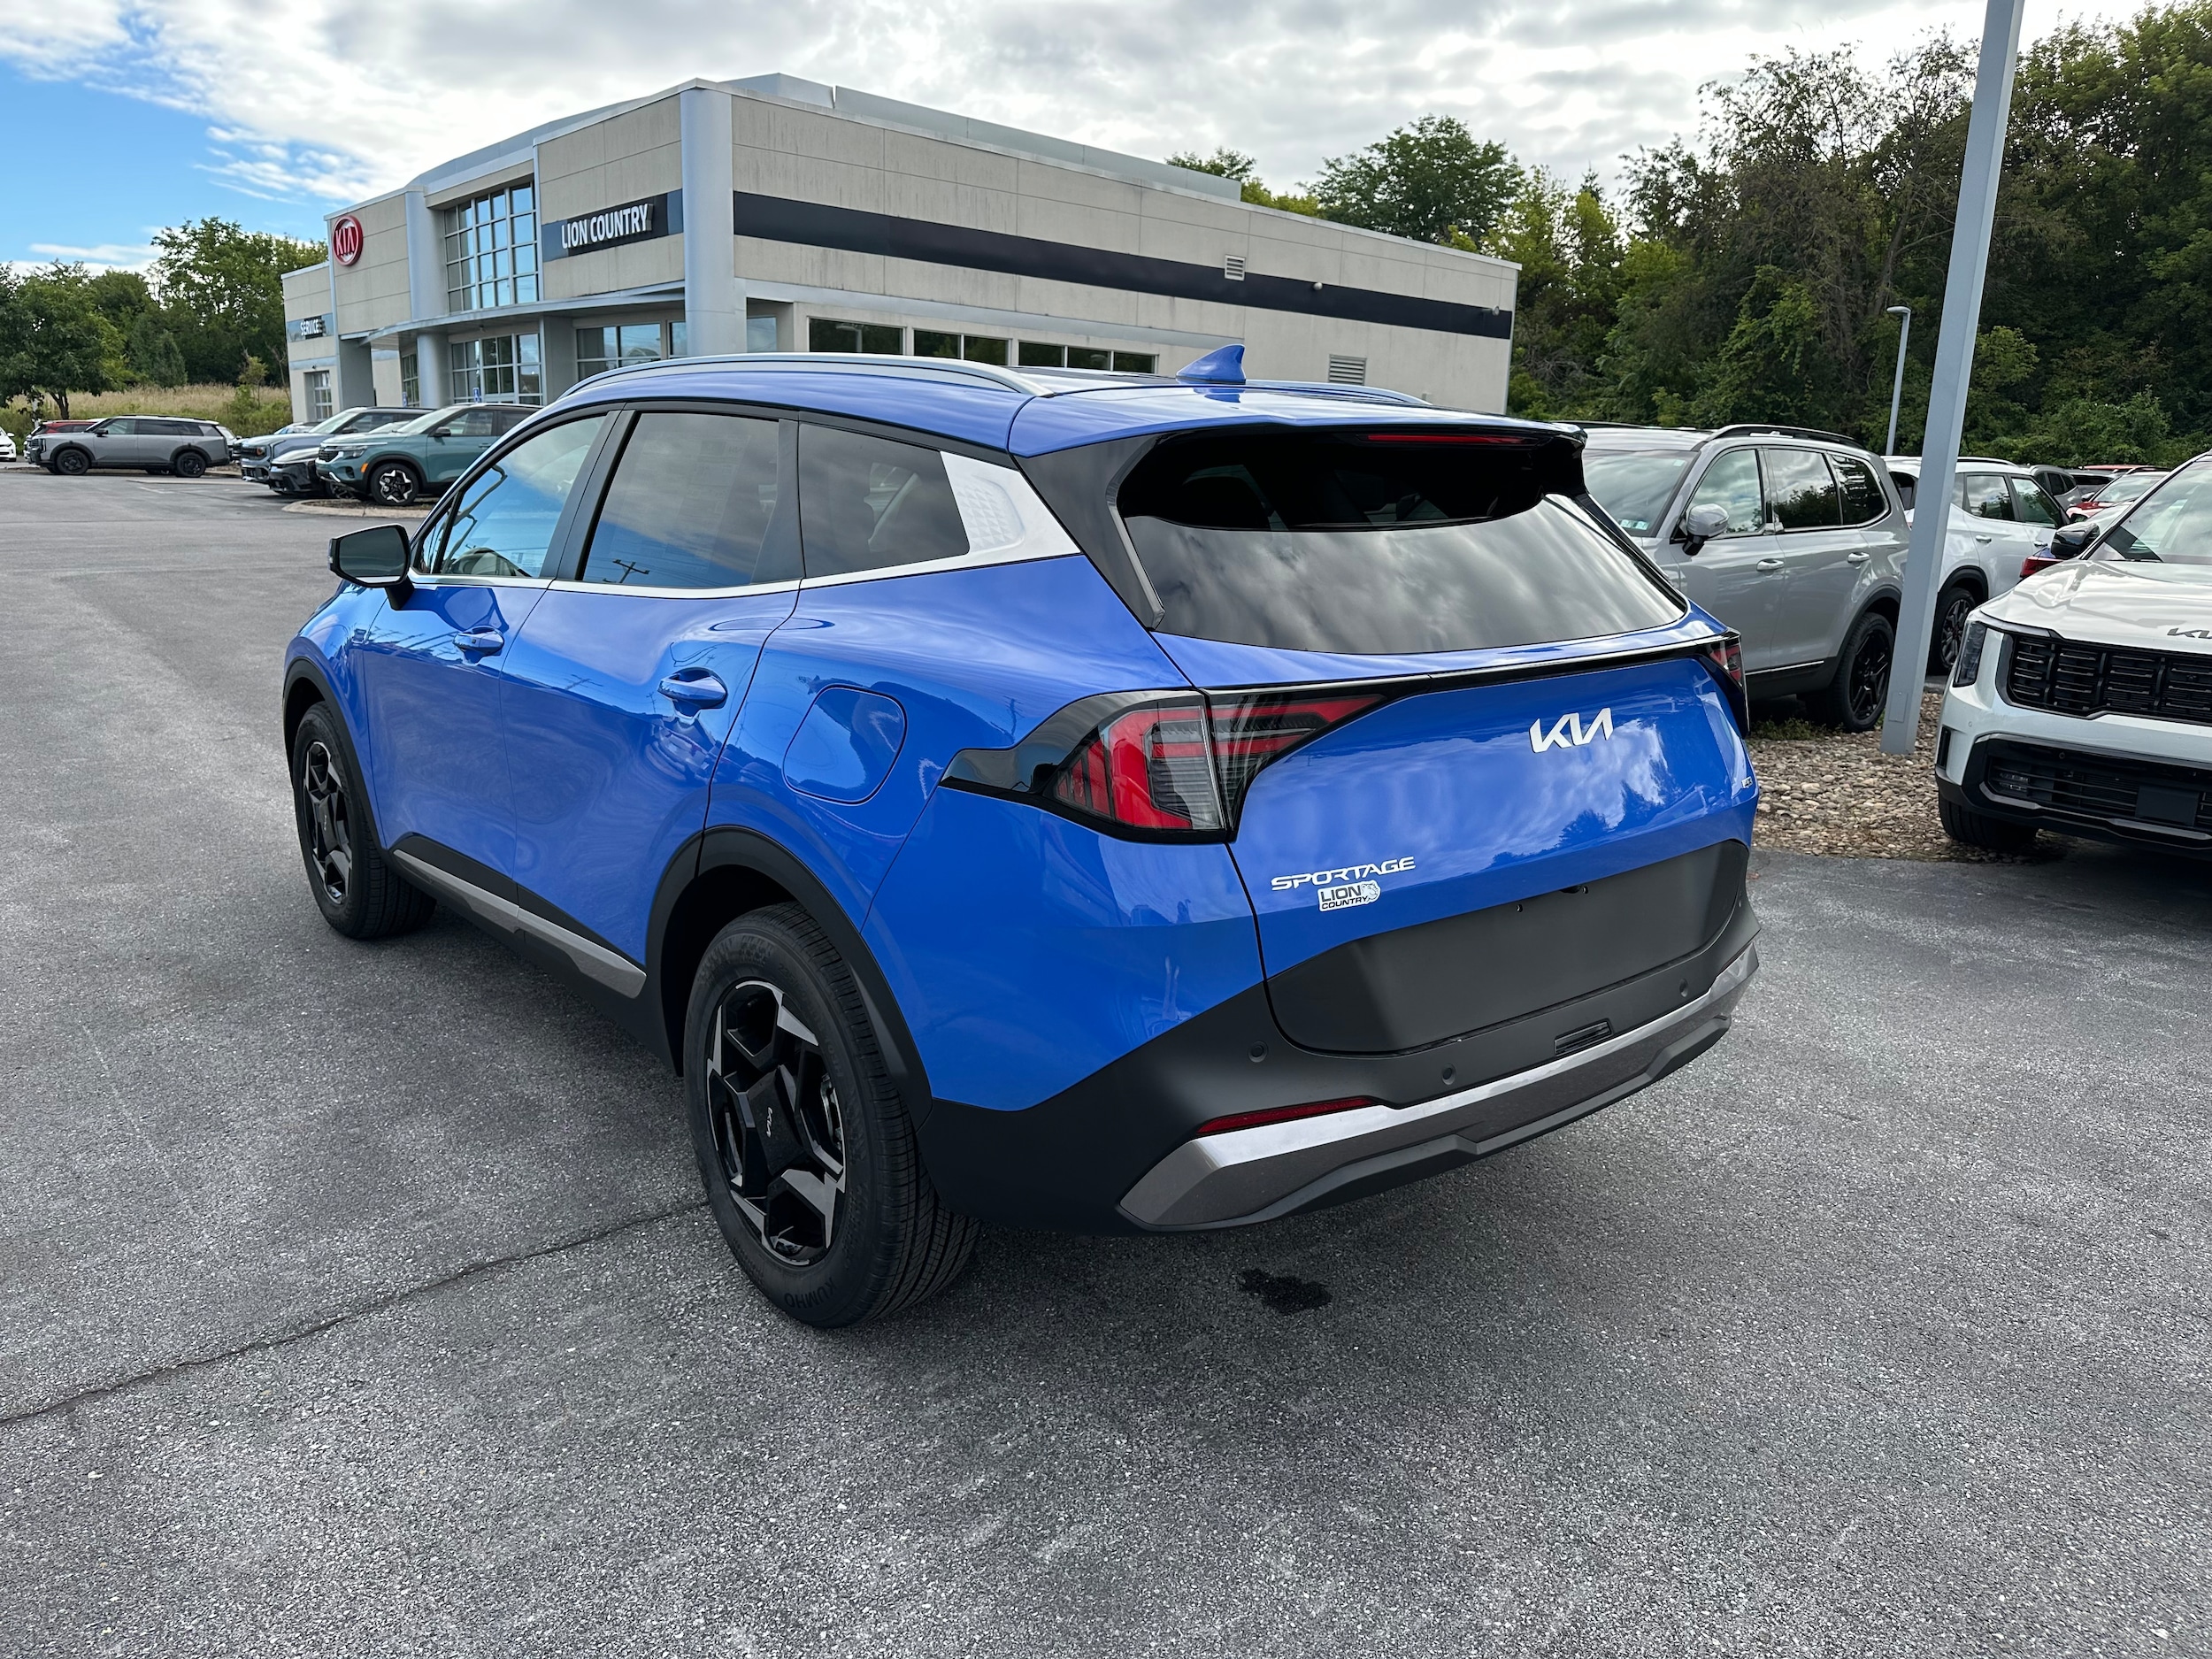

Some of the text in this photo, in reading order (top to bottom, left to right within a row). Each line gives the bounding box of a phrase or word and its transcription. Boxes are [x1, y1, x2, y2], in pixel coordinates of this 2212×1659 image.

[335, 226, 355, 256] KIA
[561, 204, 649, 249] LION COUNTRY
[300, 319, 320, 336] SERVICE
[1528, 707, 1614, 753] KIA
[1271, 856, 1416, 891] SPORTAGE
[1320, 885, 1362, 902] LION
[1321, 895, 1368, 910] COUNTRY
[784, 1277, 837, 1309] KUMHO
